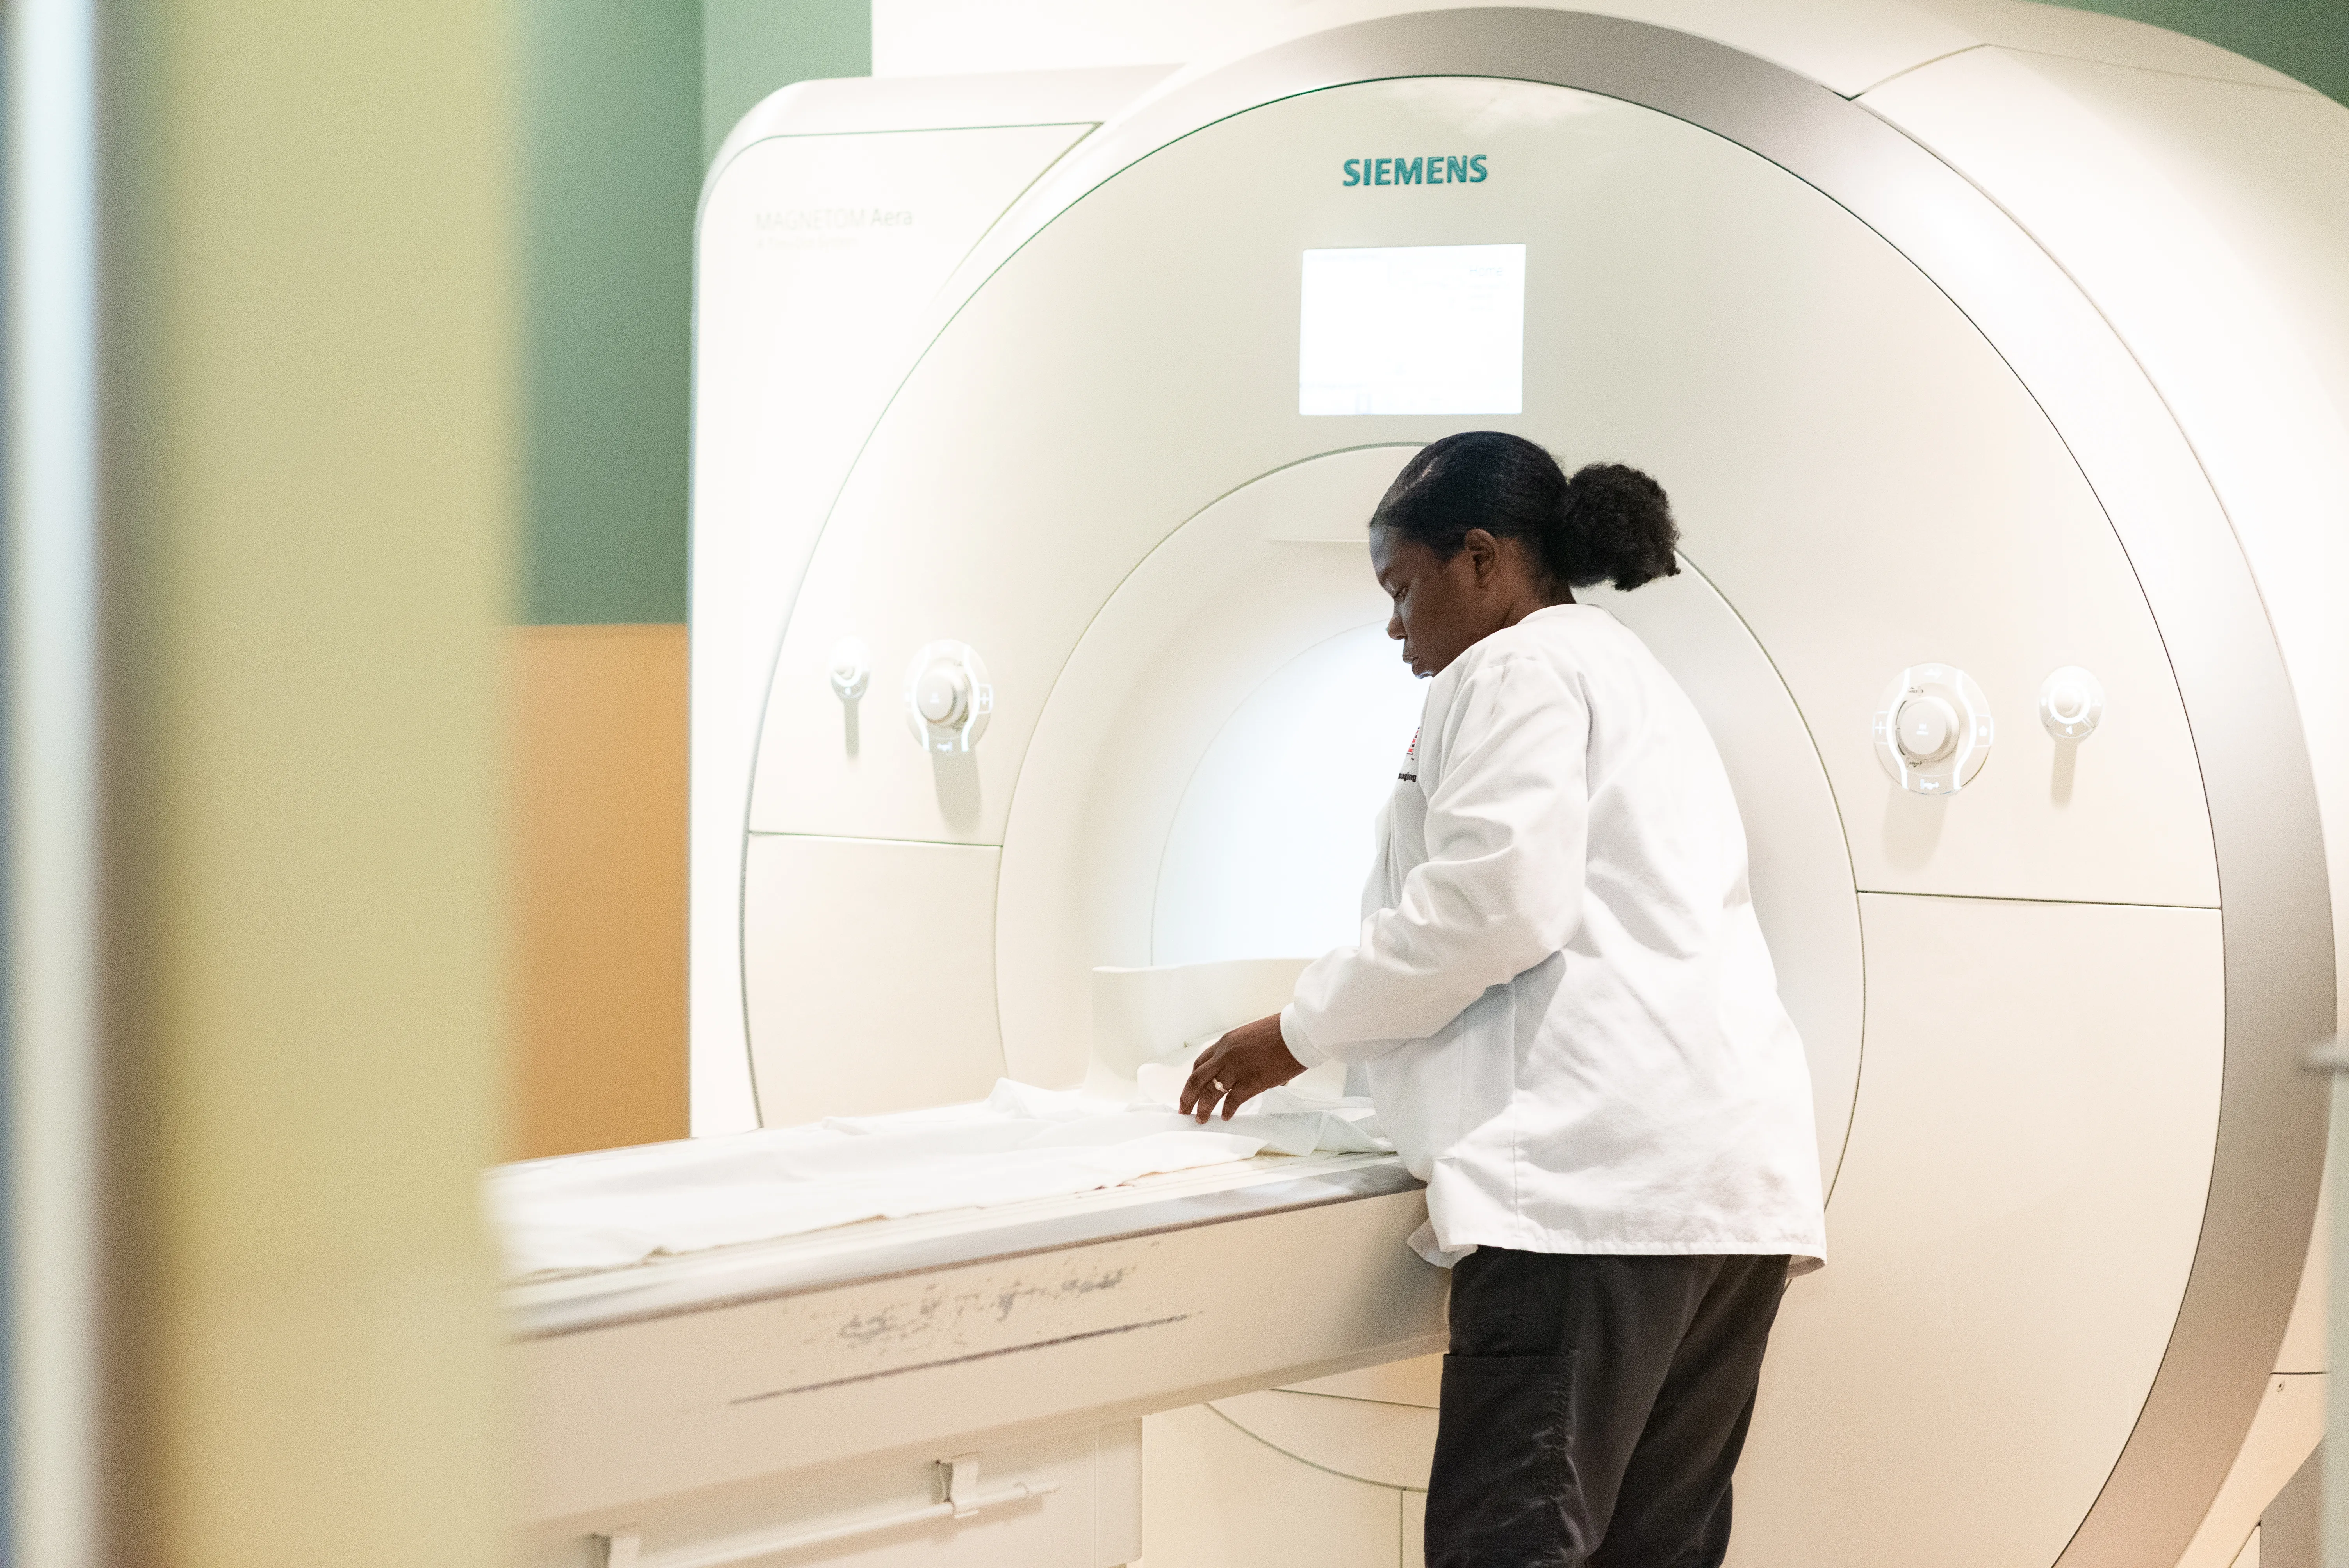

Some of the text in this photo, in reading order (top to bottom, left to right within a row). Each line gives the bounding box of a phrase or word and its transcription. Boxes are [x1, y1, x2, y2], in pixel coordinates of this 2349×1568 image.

[1342, 154, 1488, 186] SIEMENS
[755, 208, 913, 230] MAGNETOM Aera
